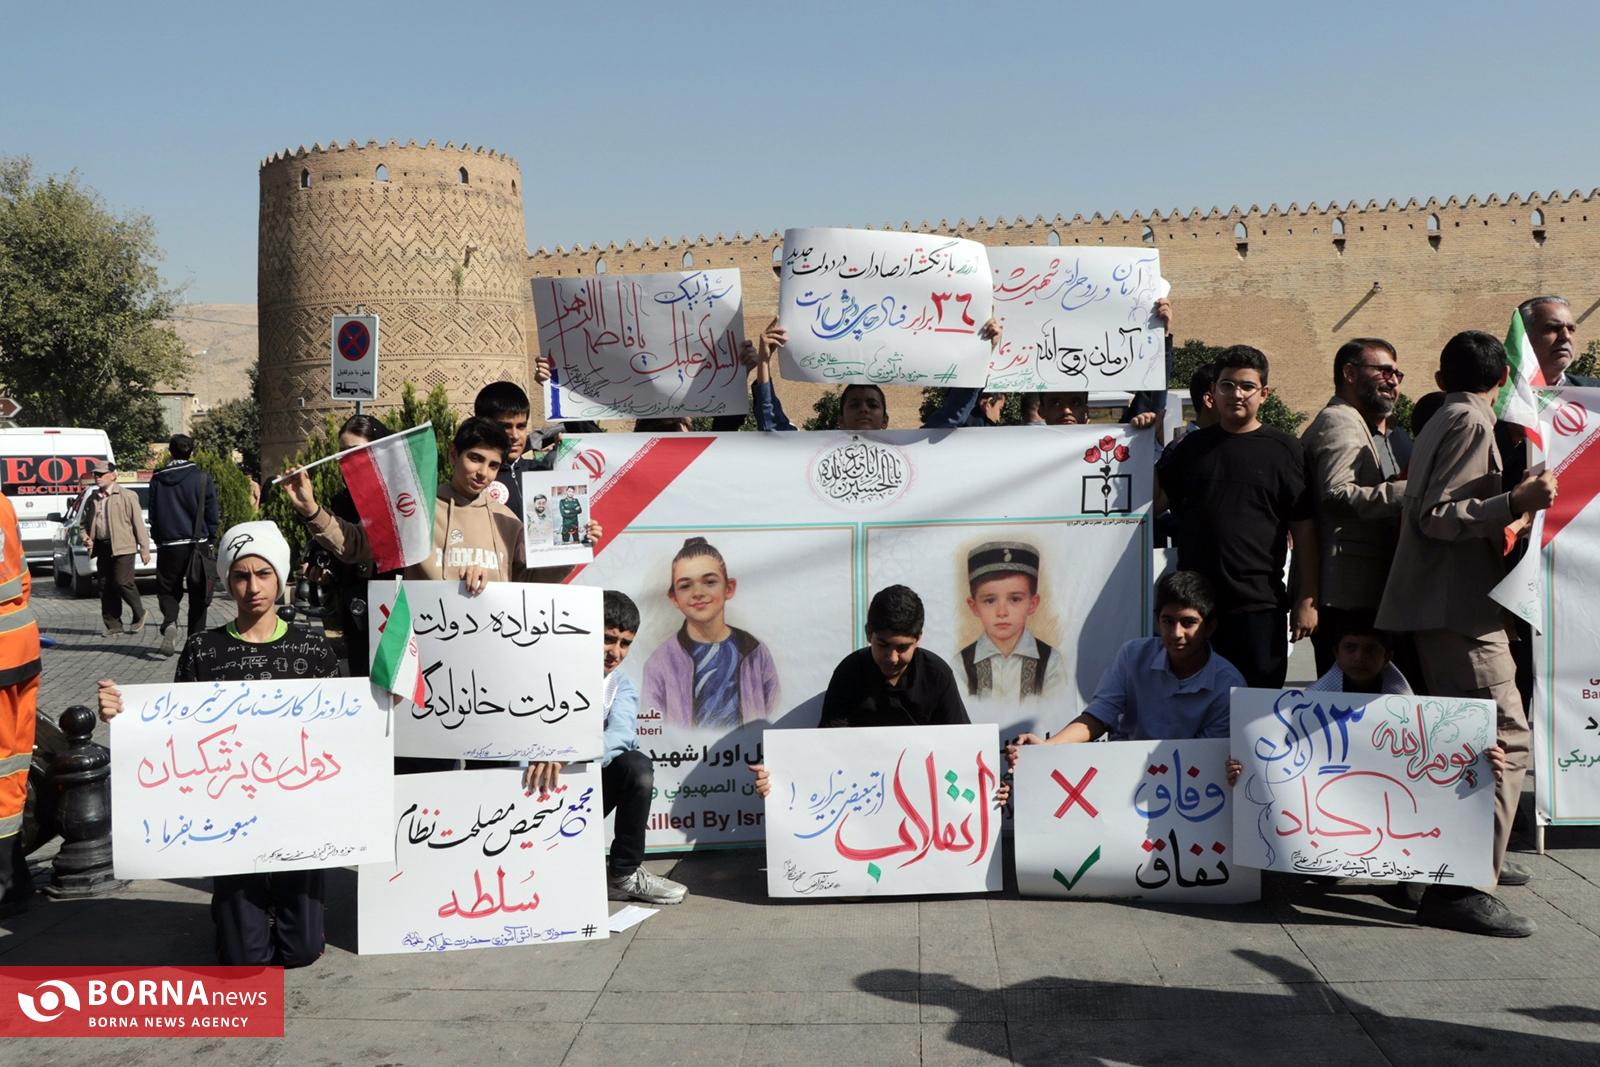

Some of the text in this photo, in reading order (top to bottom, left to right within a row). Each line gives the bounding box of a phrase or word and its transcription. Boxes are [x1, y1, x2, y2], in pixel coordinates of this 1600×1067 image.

[838, 250, 899, 280] صادرات
[1088, 326, 1142, 377] آرمان
[412, 588, 592, 648] خانواده دولت
[140, 690, 178, 726] برای
[508, 671, 591, 725] دولت
[137, 723, 342, 800] دولت پزشکیان
[649, 744, 700, 768] شهید
[664, 779, 736, 803] الصهيوني
[1133, 748, 1227, 823] وفاق
[188, 815, 259, 844] مبعوث
[426, 802, 517, 851] مصلحت
[481, 784, 570, 857] تشخیص
[703, 810, 731, 832] By
[834, 747, 996, 885] انقلاب
[1134, 828, 1231, 890] نفاق
[453, 934, 491, 950] حضرت
